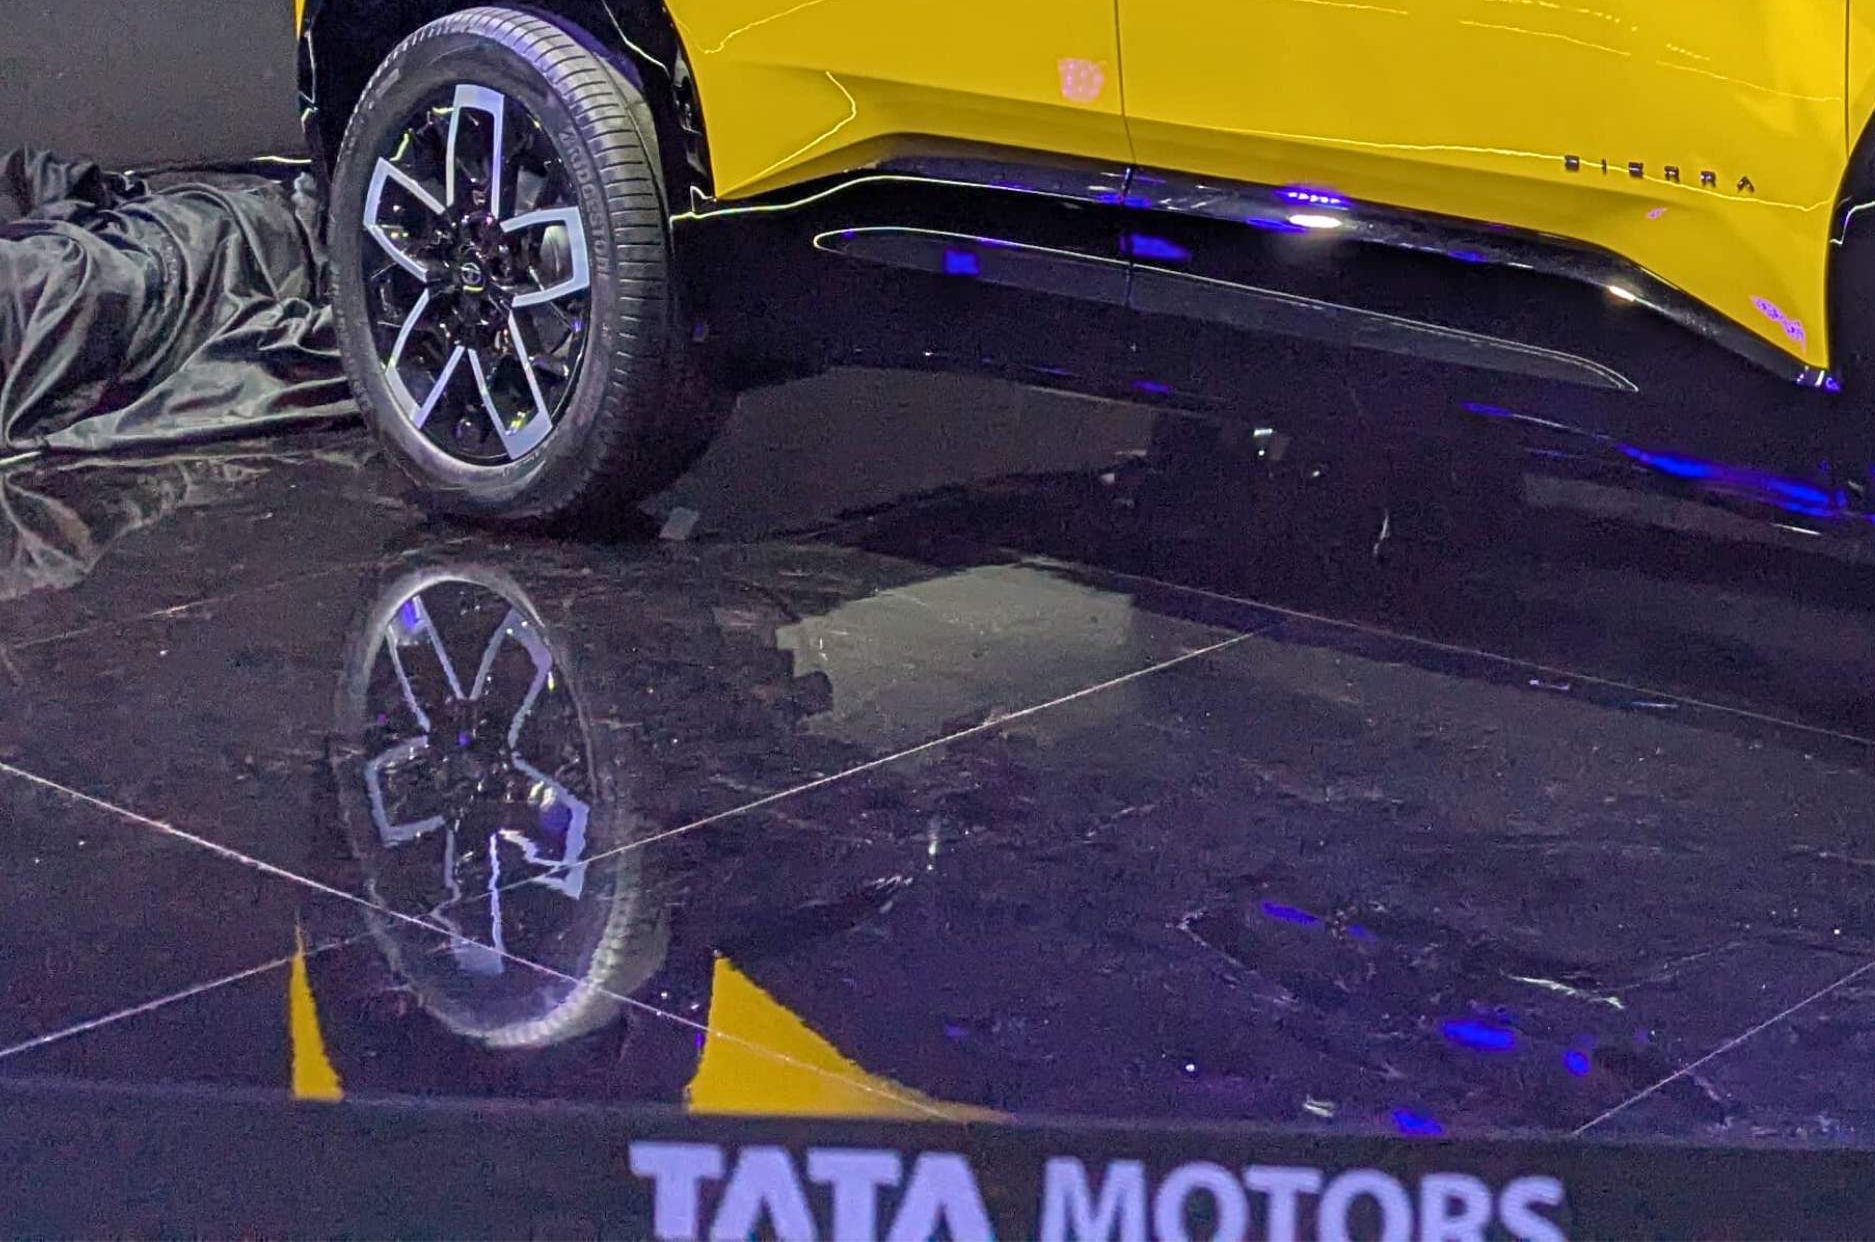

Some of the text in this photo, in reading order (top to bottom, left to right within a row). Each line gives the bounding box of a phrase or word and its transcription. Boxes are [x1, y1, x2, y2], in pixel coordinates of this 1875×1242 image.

[1564, 155, 1755, 192] SIERRA
[629, 1144, 1566, 1242] TATA MOTORS
